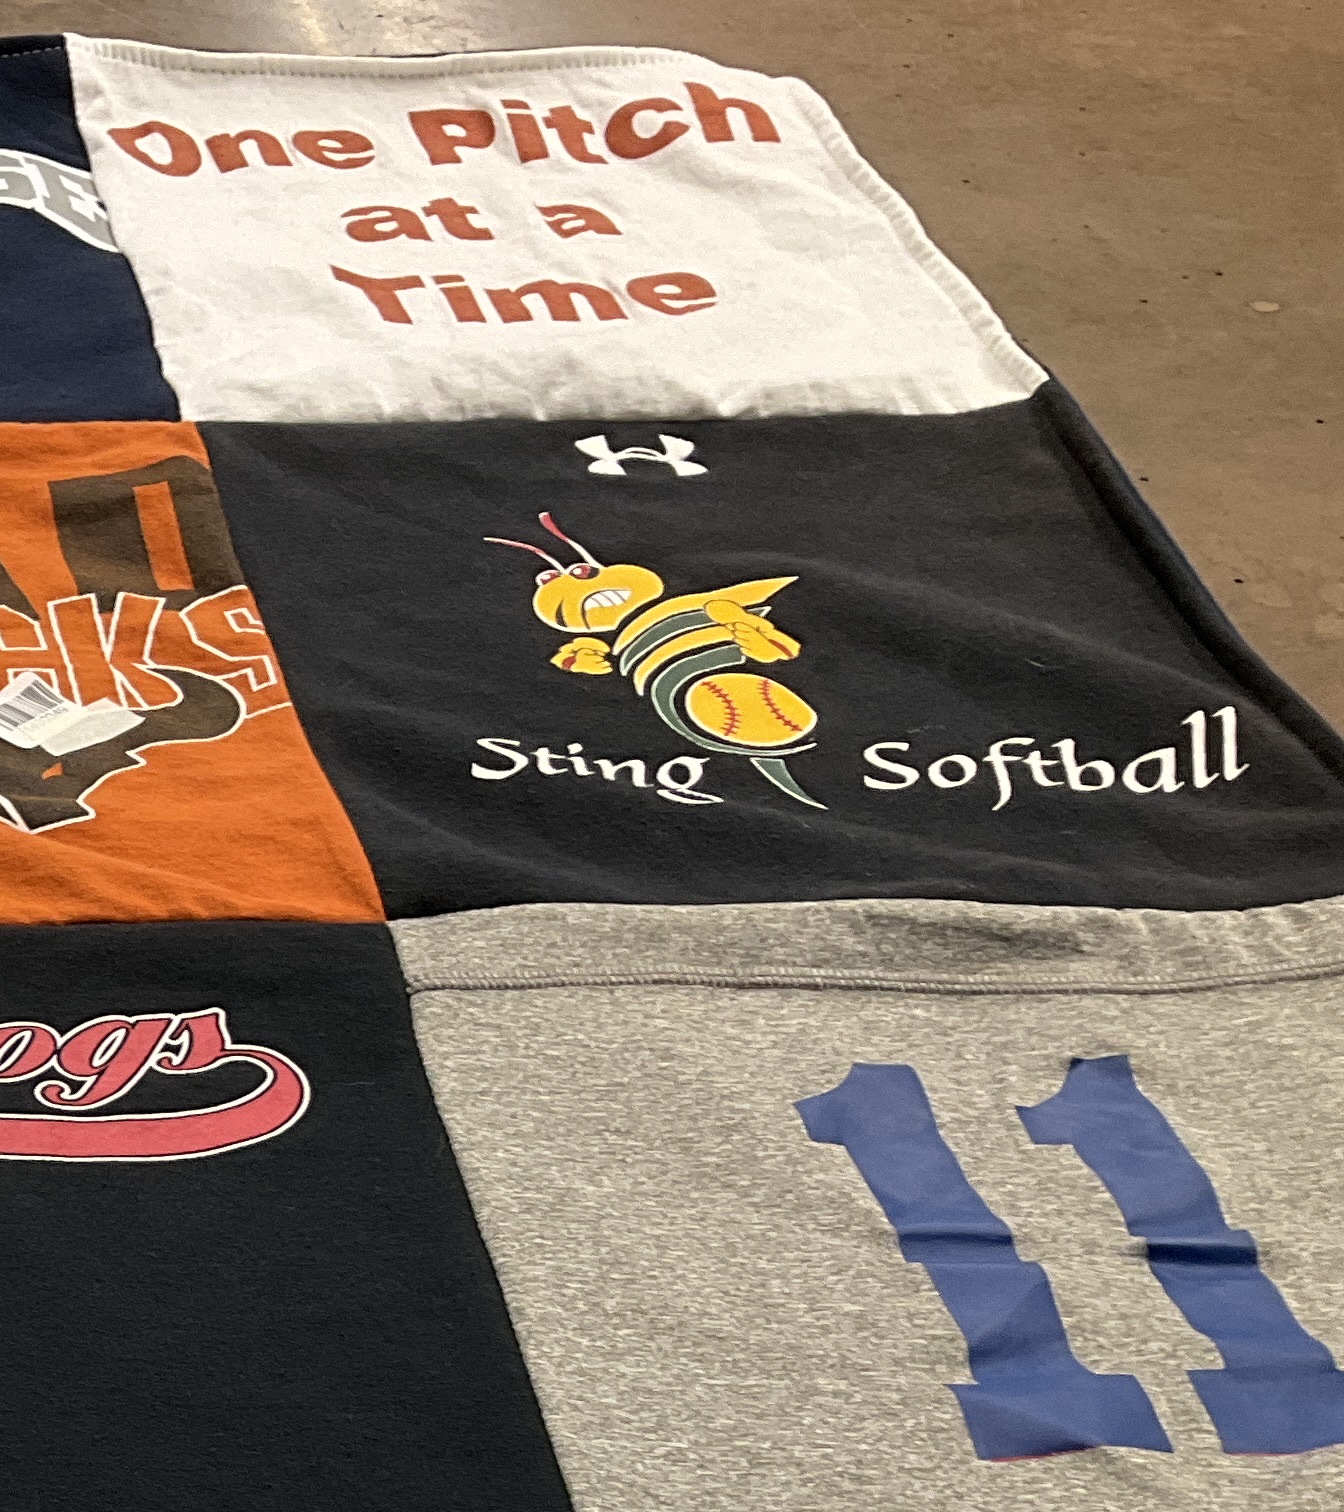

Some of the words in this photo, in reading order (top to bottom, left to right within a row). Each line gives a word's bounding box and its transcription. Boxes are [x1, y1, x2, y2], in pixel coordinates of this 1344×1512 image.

[107, 119, 376, 178] One
[407, 82, 781, 166] Pitch
[340, 196, 495, 243] at
[535, 202, 623, 240] a
[328, 263, 719, 326] Time
[470, 736, 724, 805] Sting
[862, 705, 1251, 811] Softball
[794, 1055, 1344, 1462] 11
